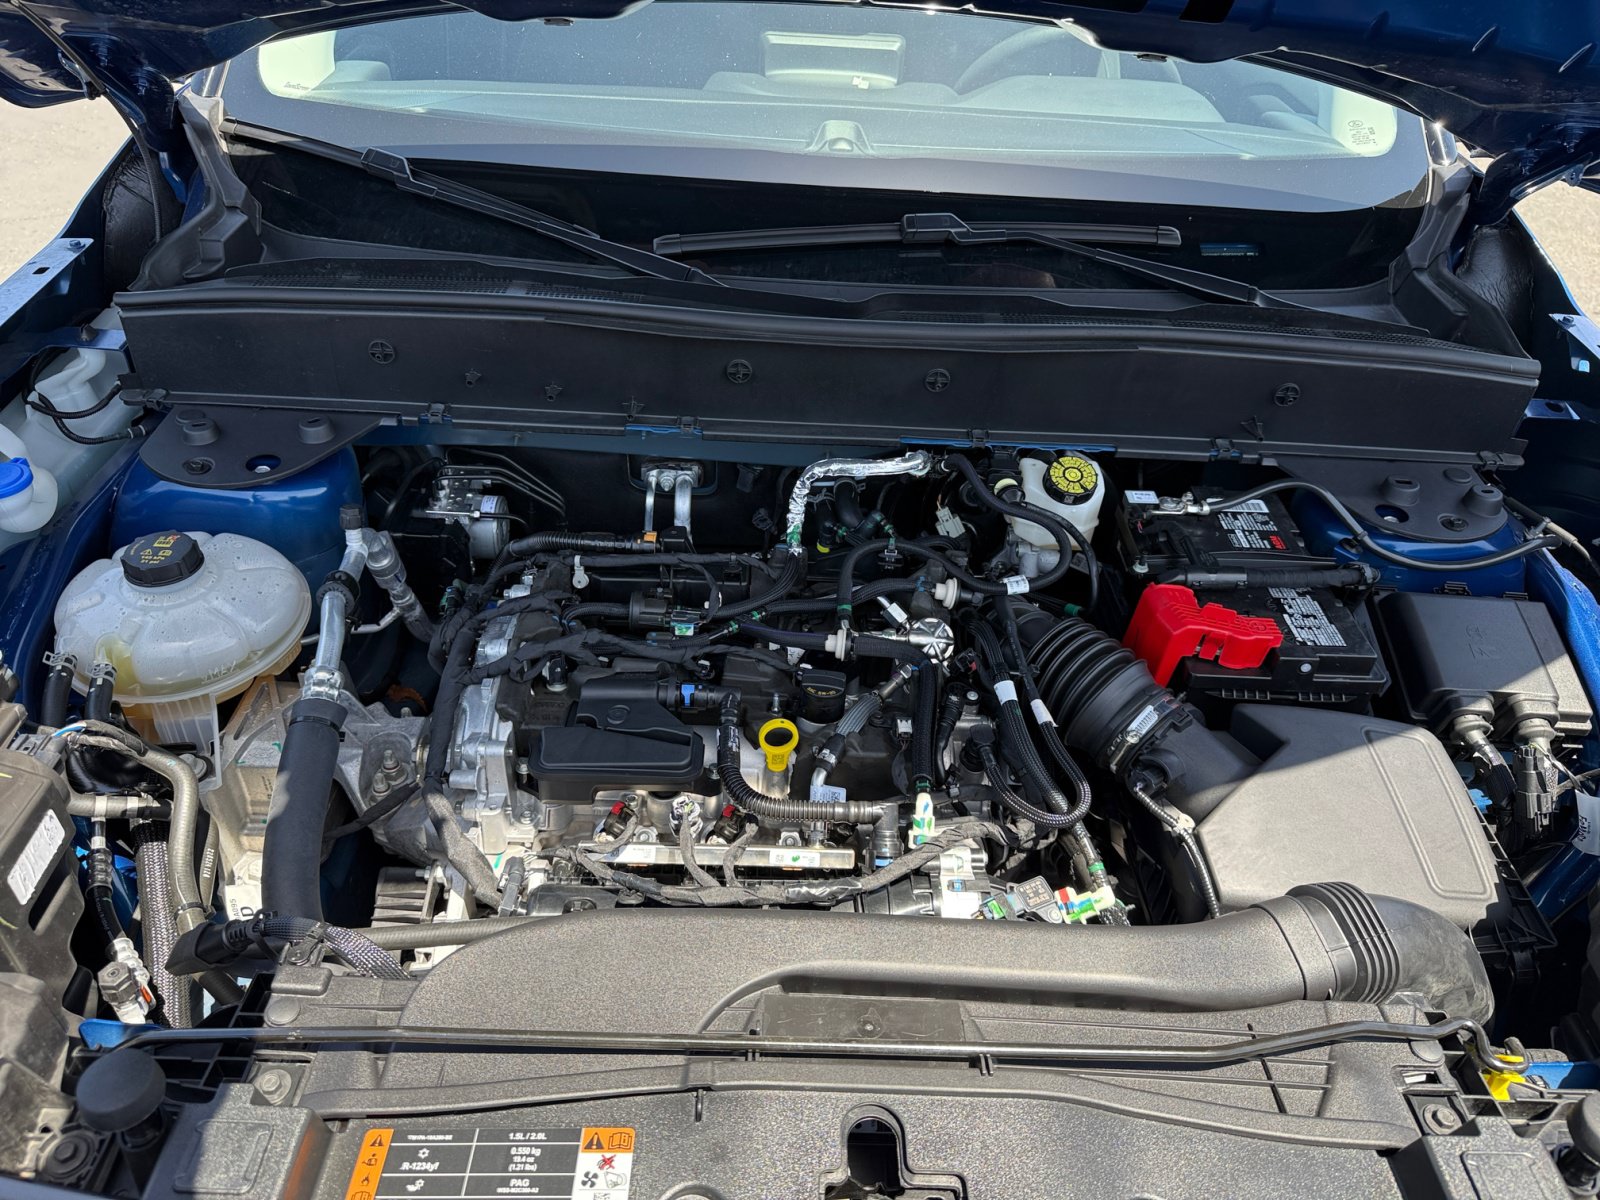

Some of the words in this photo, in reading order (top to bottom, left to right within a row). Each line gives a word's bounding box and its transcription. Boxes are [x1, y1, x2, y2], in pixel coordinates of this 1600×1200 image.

[508, 1132, 525, 1140] 1.5L
[530, 1132, 547, 1140] 2.0L
[510, 1147, 530, 1155] 0.550
[509, 1178, 530, 1187] PAG
